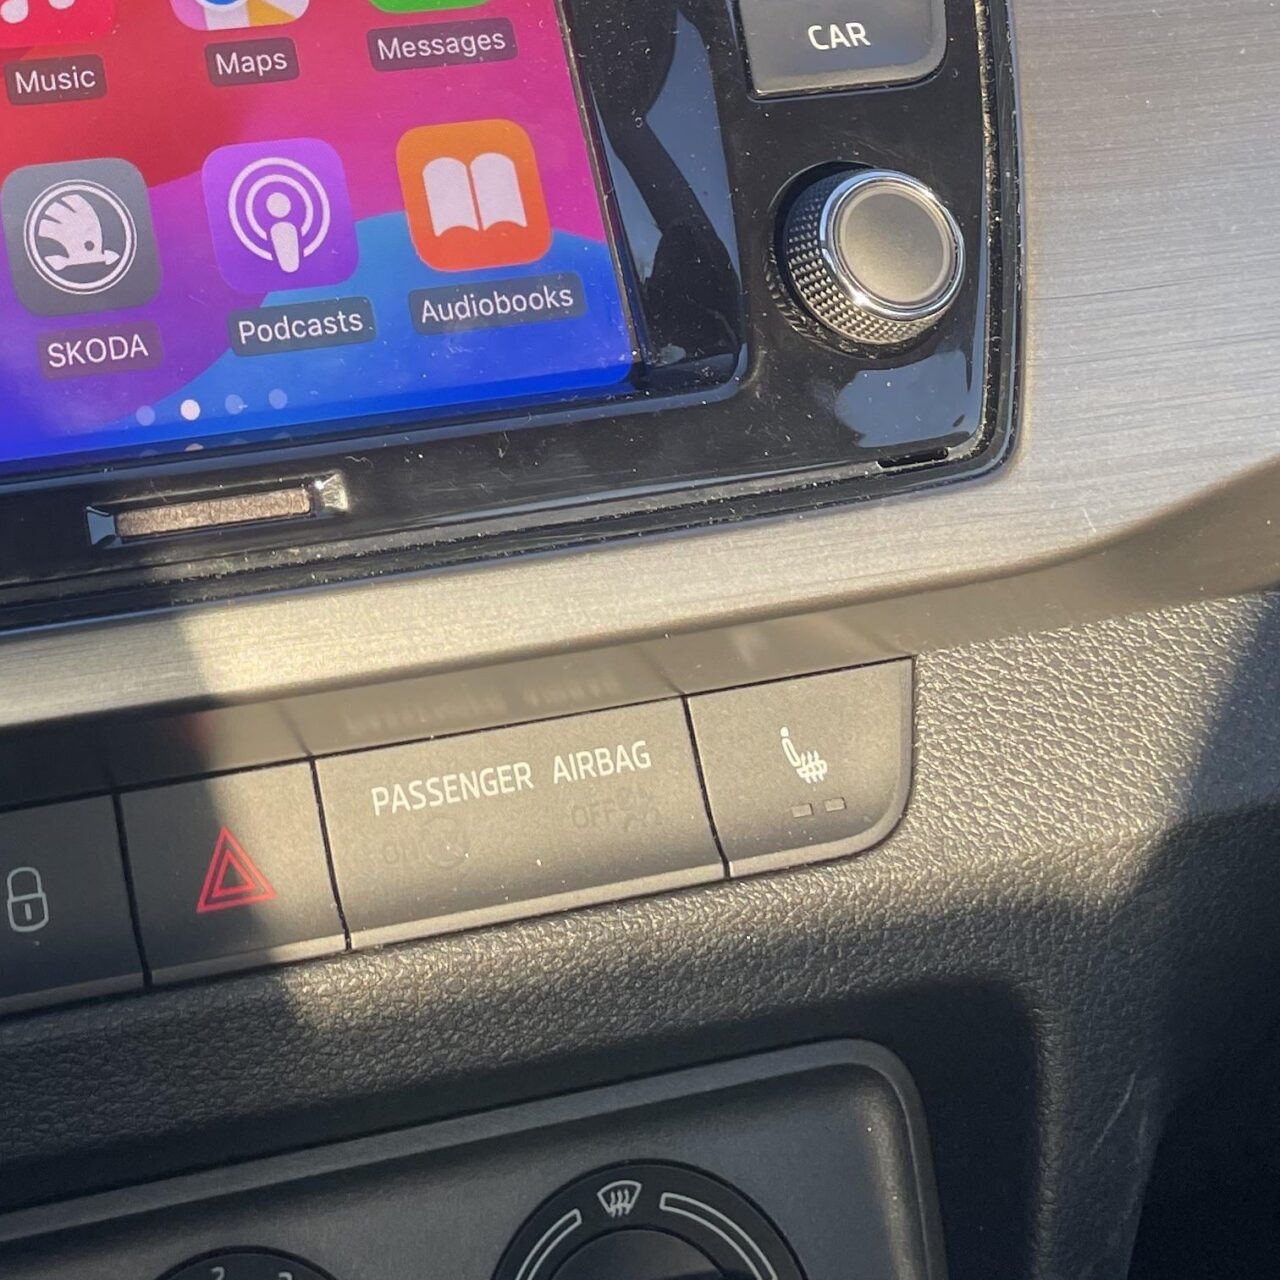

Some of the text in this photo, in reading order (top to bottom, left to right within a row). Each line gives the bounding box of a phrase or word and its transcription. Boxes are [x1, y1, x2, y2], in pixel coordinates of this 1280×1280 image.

[376, 28, 507, 61] Messages
[807, 22, 872, 51] CAR
[14, 64, 97, 95] Music
[214, 49, 288, 78] Maps
[420, 285, 574, 324] Audiobooks
[238, 310, 364, 345] Podcasts
[46, 333, 150, 369] SKODA
[370, 739, 653, 817] PASSENGER AIRBAG
